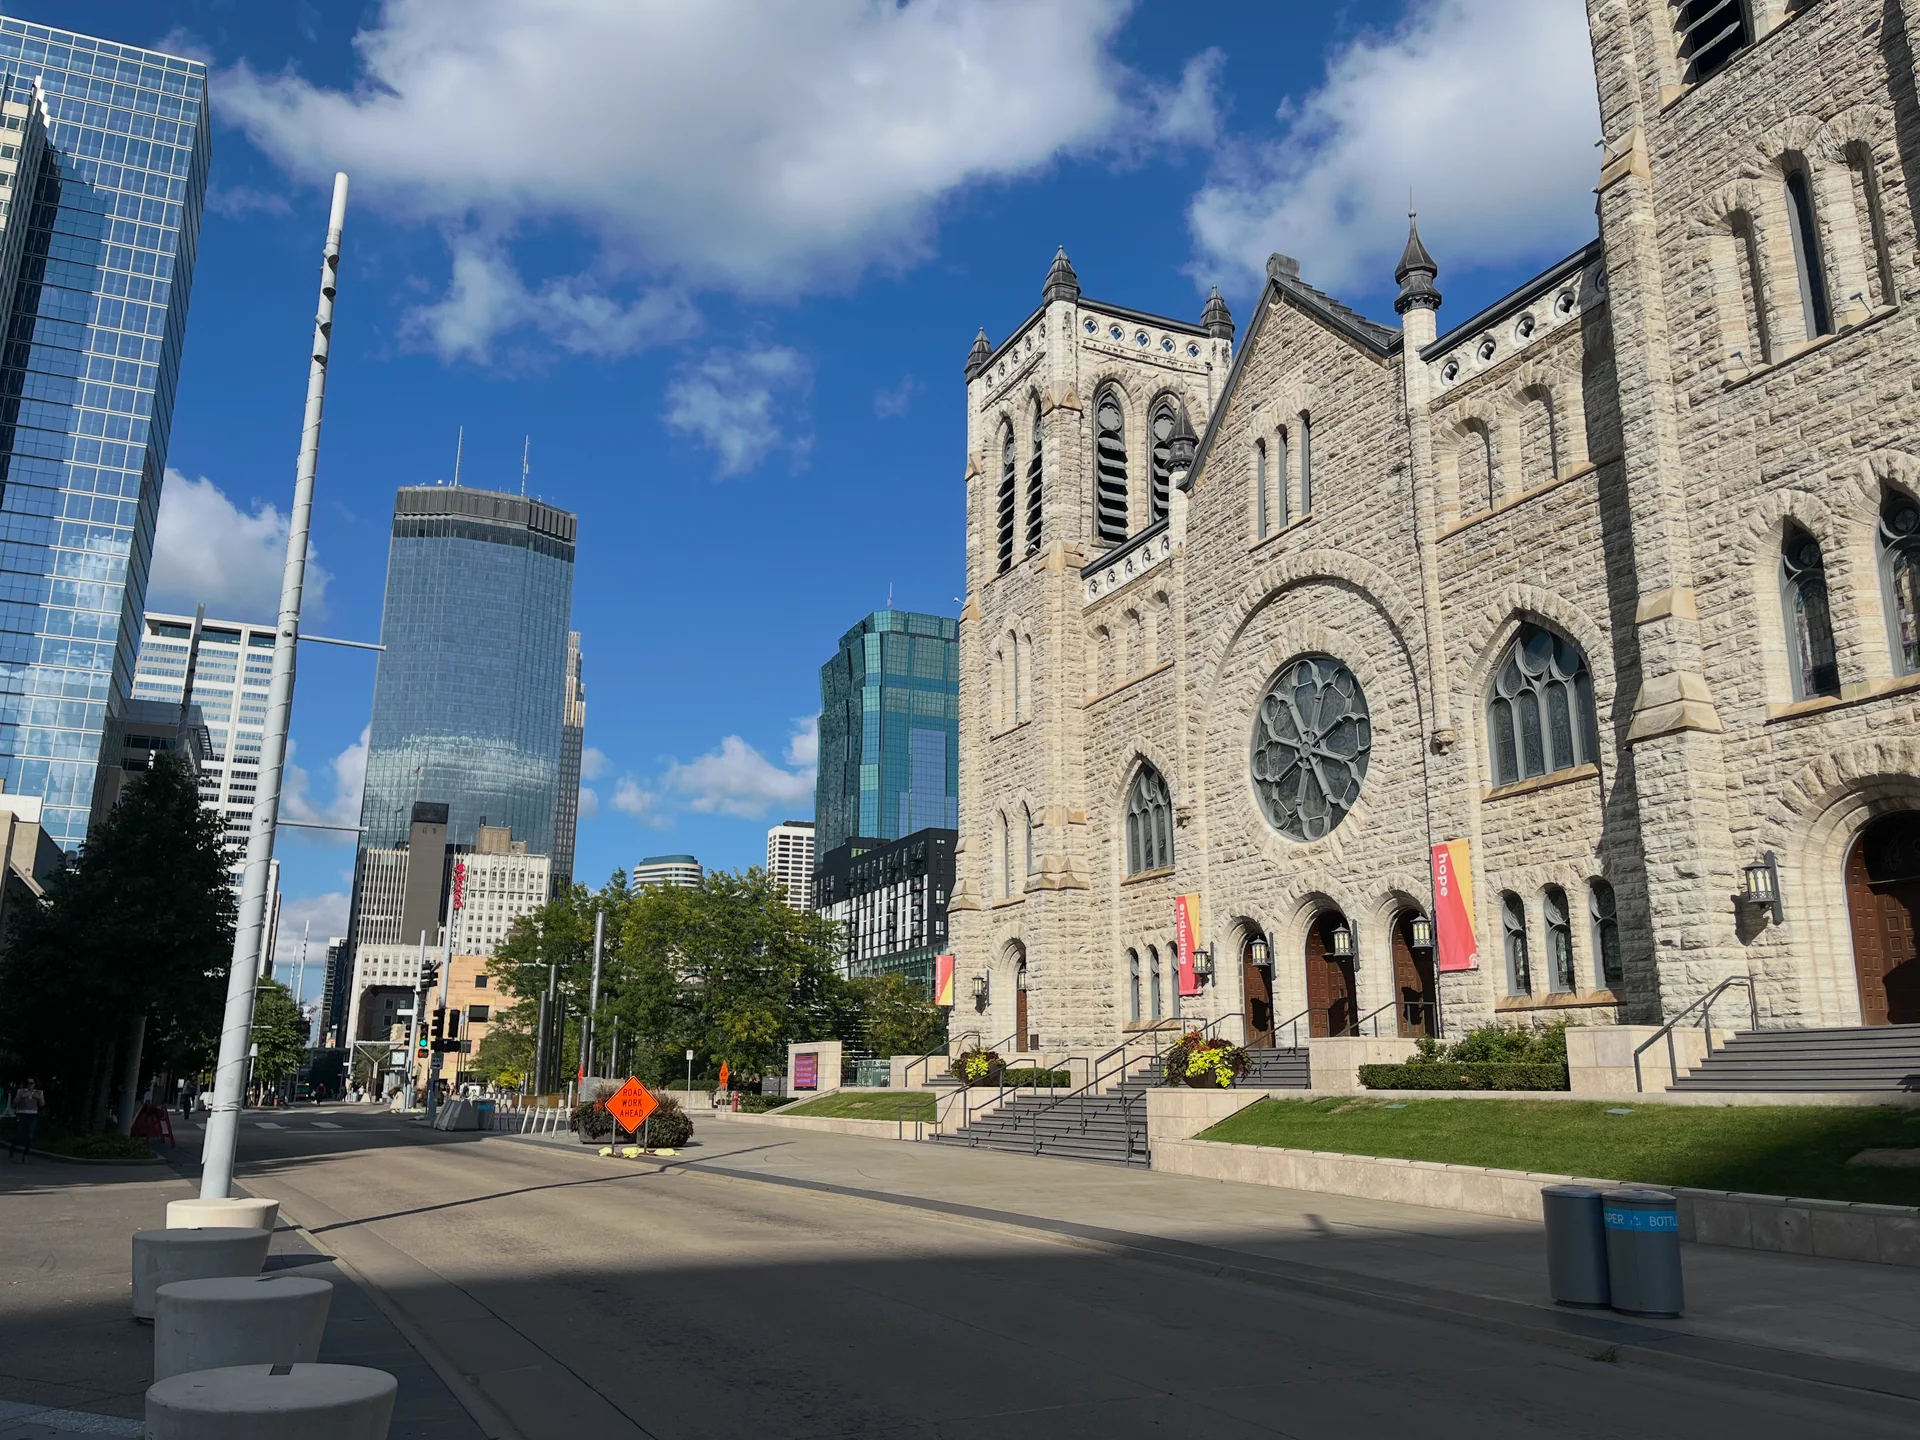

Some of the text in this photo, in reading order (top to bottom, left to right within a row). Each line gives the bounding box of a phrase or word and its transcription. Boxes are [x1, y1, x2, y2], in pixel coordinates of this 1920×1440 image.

[1437, 853, 1448, 896] hope
[1179, 903, 1187, 965] enduring
[622, 1088, 643, 1097] ROAD
[622, 1098, 643, 1107] WORK
[619, 1109, 644, 1118] AHEAD
